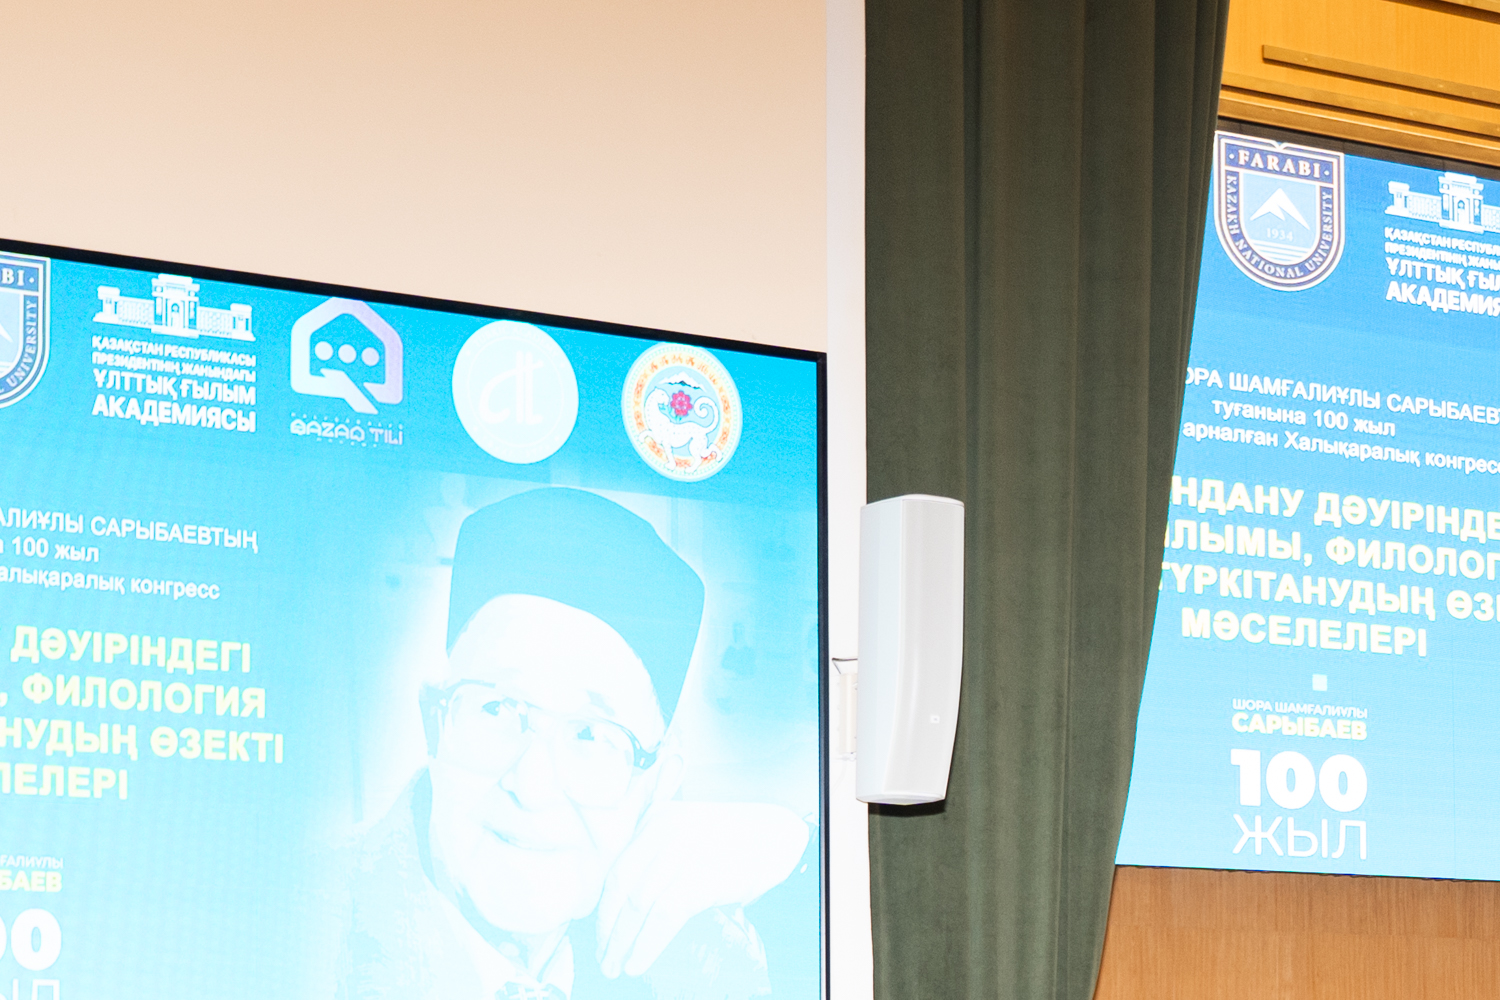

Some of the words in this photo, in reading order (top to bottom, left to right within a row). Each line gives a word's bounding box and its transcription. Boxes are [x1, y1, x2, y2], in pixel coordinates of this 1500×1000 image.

[1238, 149, 1321, 178] FARABI
[1226, 175, 1240, 235] KAZAKH
[1235, 238, 1304, 279] NATIONAL
[1304, 191, 1333, 271] UNIVERSITY
[1266, 227, 1293, 242] 1934
[1384, 227, 1450, 248] ҚАЗАҚСТАН
[1385, 257, 1466, 290] ҰЛТТЫҚ
[6, 299, 38, 389] UNIVERSITY
[92, 335, 164, 357] ҚАЗАҚСТАН
[164, 344, 256, 368] РЕСПУБЛИКАСЫ
[93, 368, 178, 400] ҰЛТТЫҚ
[180, 378, 256, 406] ҒЫЛЫМ
[1228, 371, 1381, 410] ШАМҒАЛИҰЛЫ
[92, 393, 256, 433] АКАДЕМИЯСЫ
[289, 418, 365, 442] QAZAQ
[1211, 399, 1306, 425] туғанына
[1312, 408, 1348, 430] 100
[1353, 417, 1396, 437] жыл
[1182, 421, 1278, 448] арналған
[1284, 430, 1421, 467] Халықаралық
[1171, 475, 1304, 518] НДАНУ
[11, 535, 49, 558] 100
[54, 543, 99, 563] жыл
[90, 515, 259, 554] САРЫБАЕВТЫҢ
[1164, 518, 1313, 567] ЛЫМЫ,
[130, 576, 221, 601] конгресс
[10, 625, 251, 675] ДӘУІРІНДЕГІ
[1181, 606, 1428, 658] МӘСЕЛЕЛЕРІ
[22, 672, 266, 719] ФИЛОЛОГИЯ
[1232, 698, 1273, 712] ШОРА
[150, 726, 284, 764] ӨЗЕКТІ
[1231, 711, 1368, 741] САРЫБАЕВ
[1230, 748, 1368, 813] 100
[1232, 813, 1368, 861] ЖЫЛ
